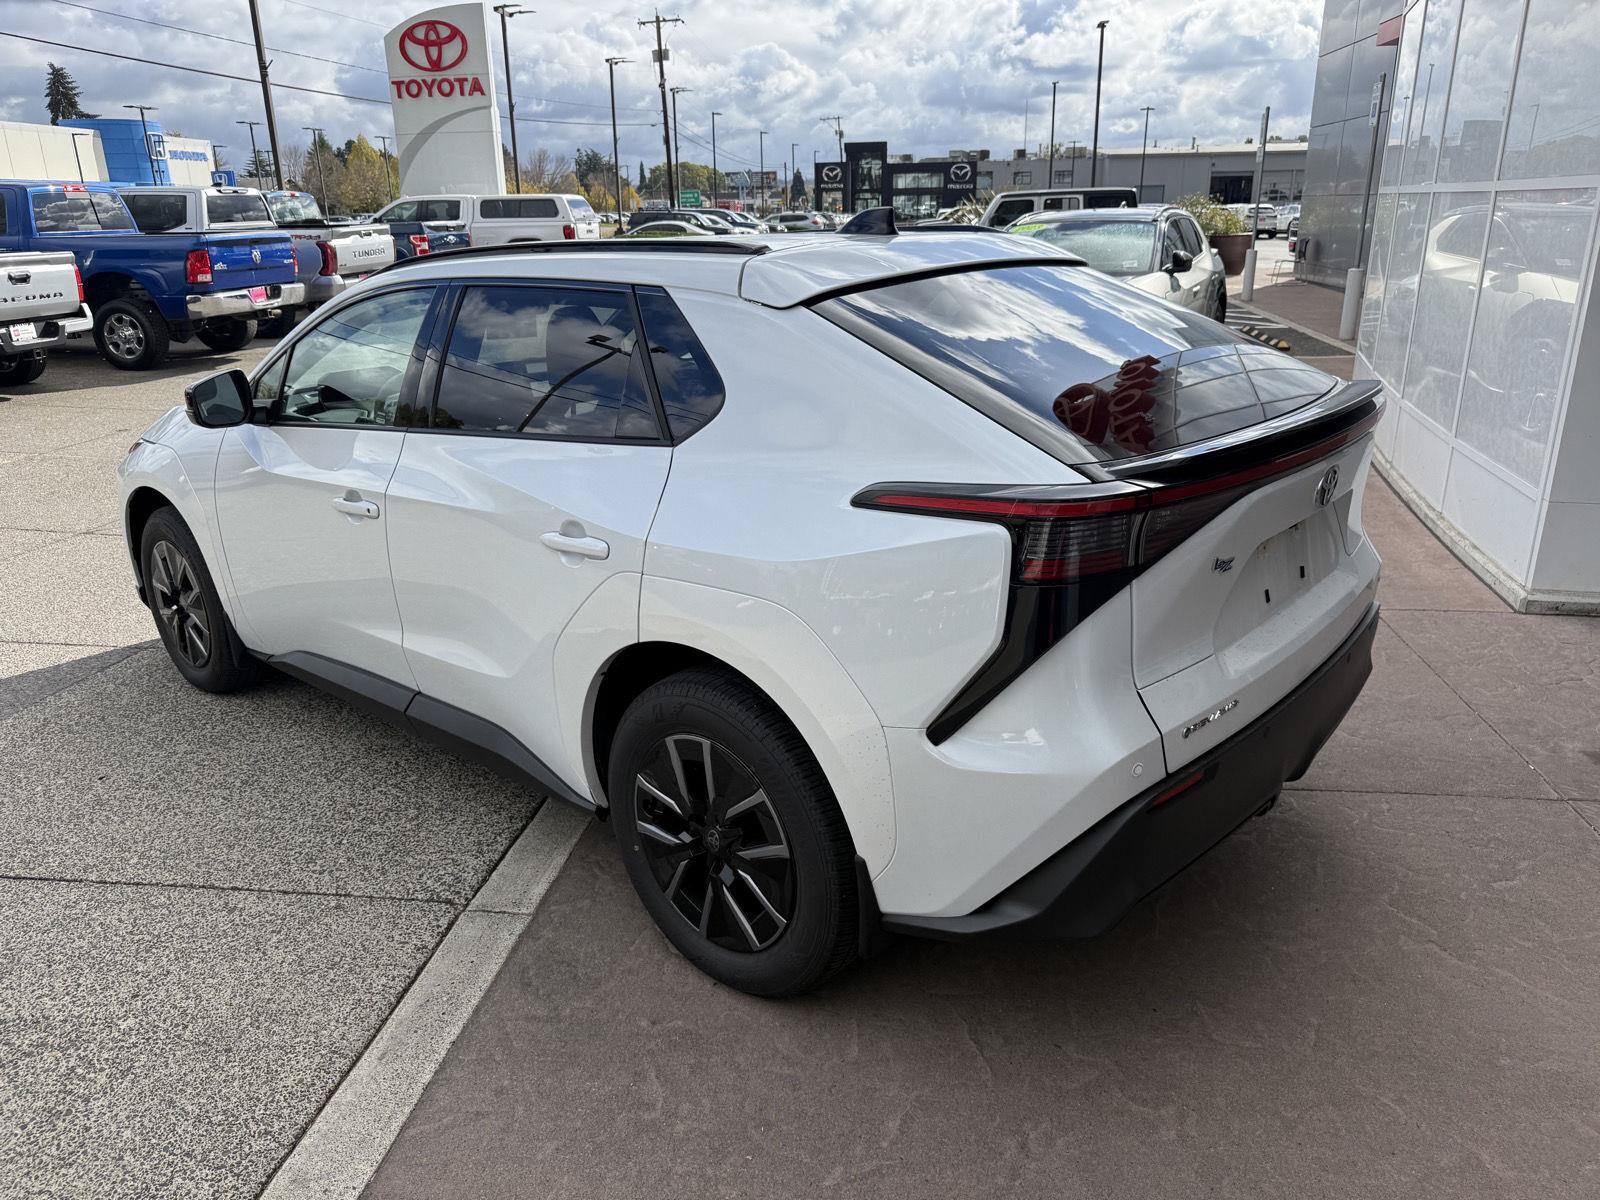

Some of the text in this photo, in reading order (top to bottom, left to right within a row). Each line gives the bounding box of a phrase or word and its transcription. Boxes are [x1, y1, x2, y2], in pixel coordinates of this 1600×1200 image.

[391, 77, 486, 99] TOYOTA
[352, 247, 386, 260] TUNDRA
[0, 292, 64, 303] ACOMA
